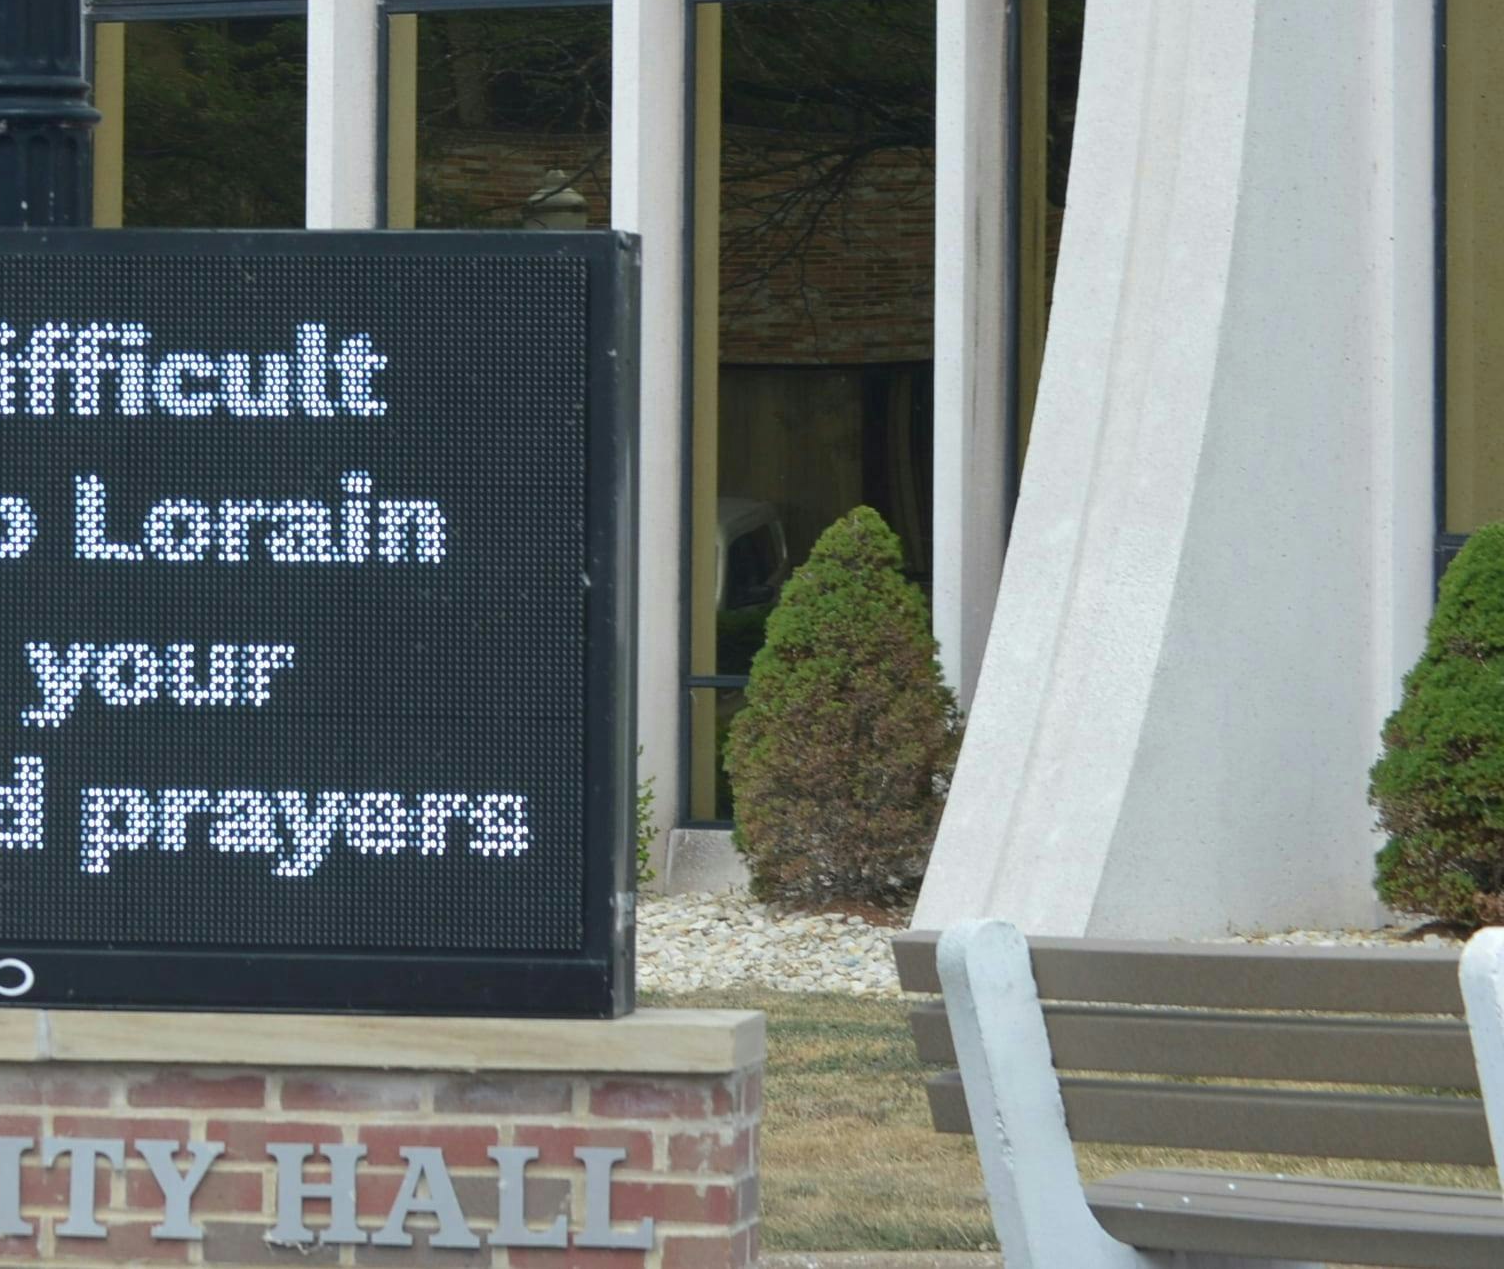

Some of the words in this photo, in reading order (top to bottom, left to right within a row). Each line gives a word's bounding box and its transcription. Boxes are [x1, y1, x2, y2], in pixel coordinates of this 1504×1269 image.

[74, 470, 447, 564] Lorain
[21, 642, 295, 728] your
[80, 787, 534, 877] prayers
[264, 1142, 655, 1250] HALL
